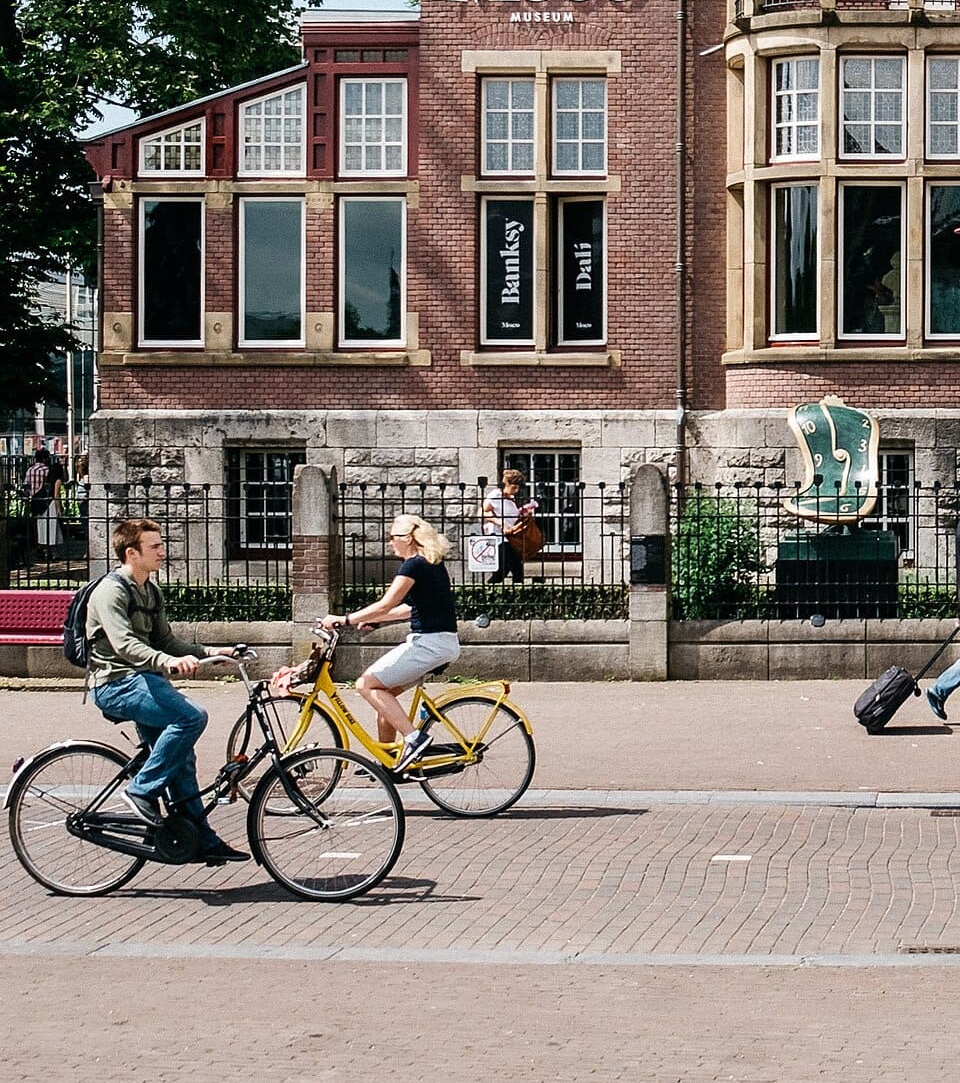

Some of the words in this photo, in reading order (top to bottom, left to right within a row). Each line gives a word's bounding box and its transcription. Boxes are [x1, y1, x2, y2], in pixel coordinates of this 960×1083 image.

[510, 12, 574, 22] MUSEUM
[499, 217, 525, 305] Banksy
[862, 419, 870, 429] 2
[857, 439, 867, 453] 3
[814, 453, 823, 468] 9
